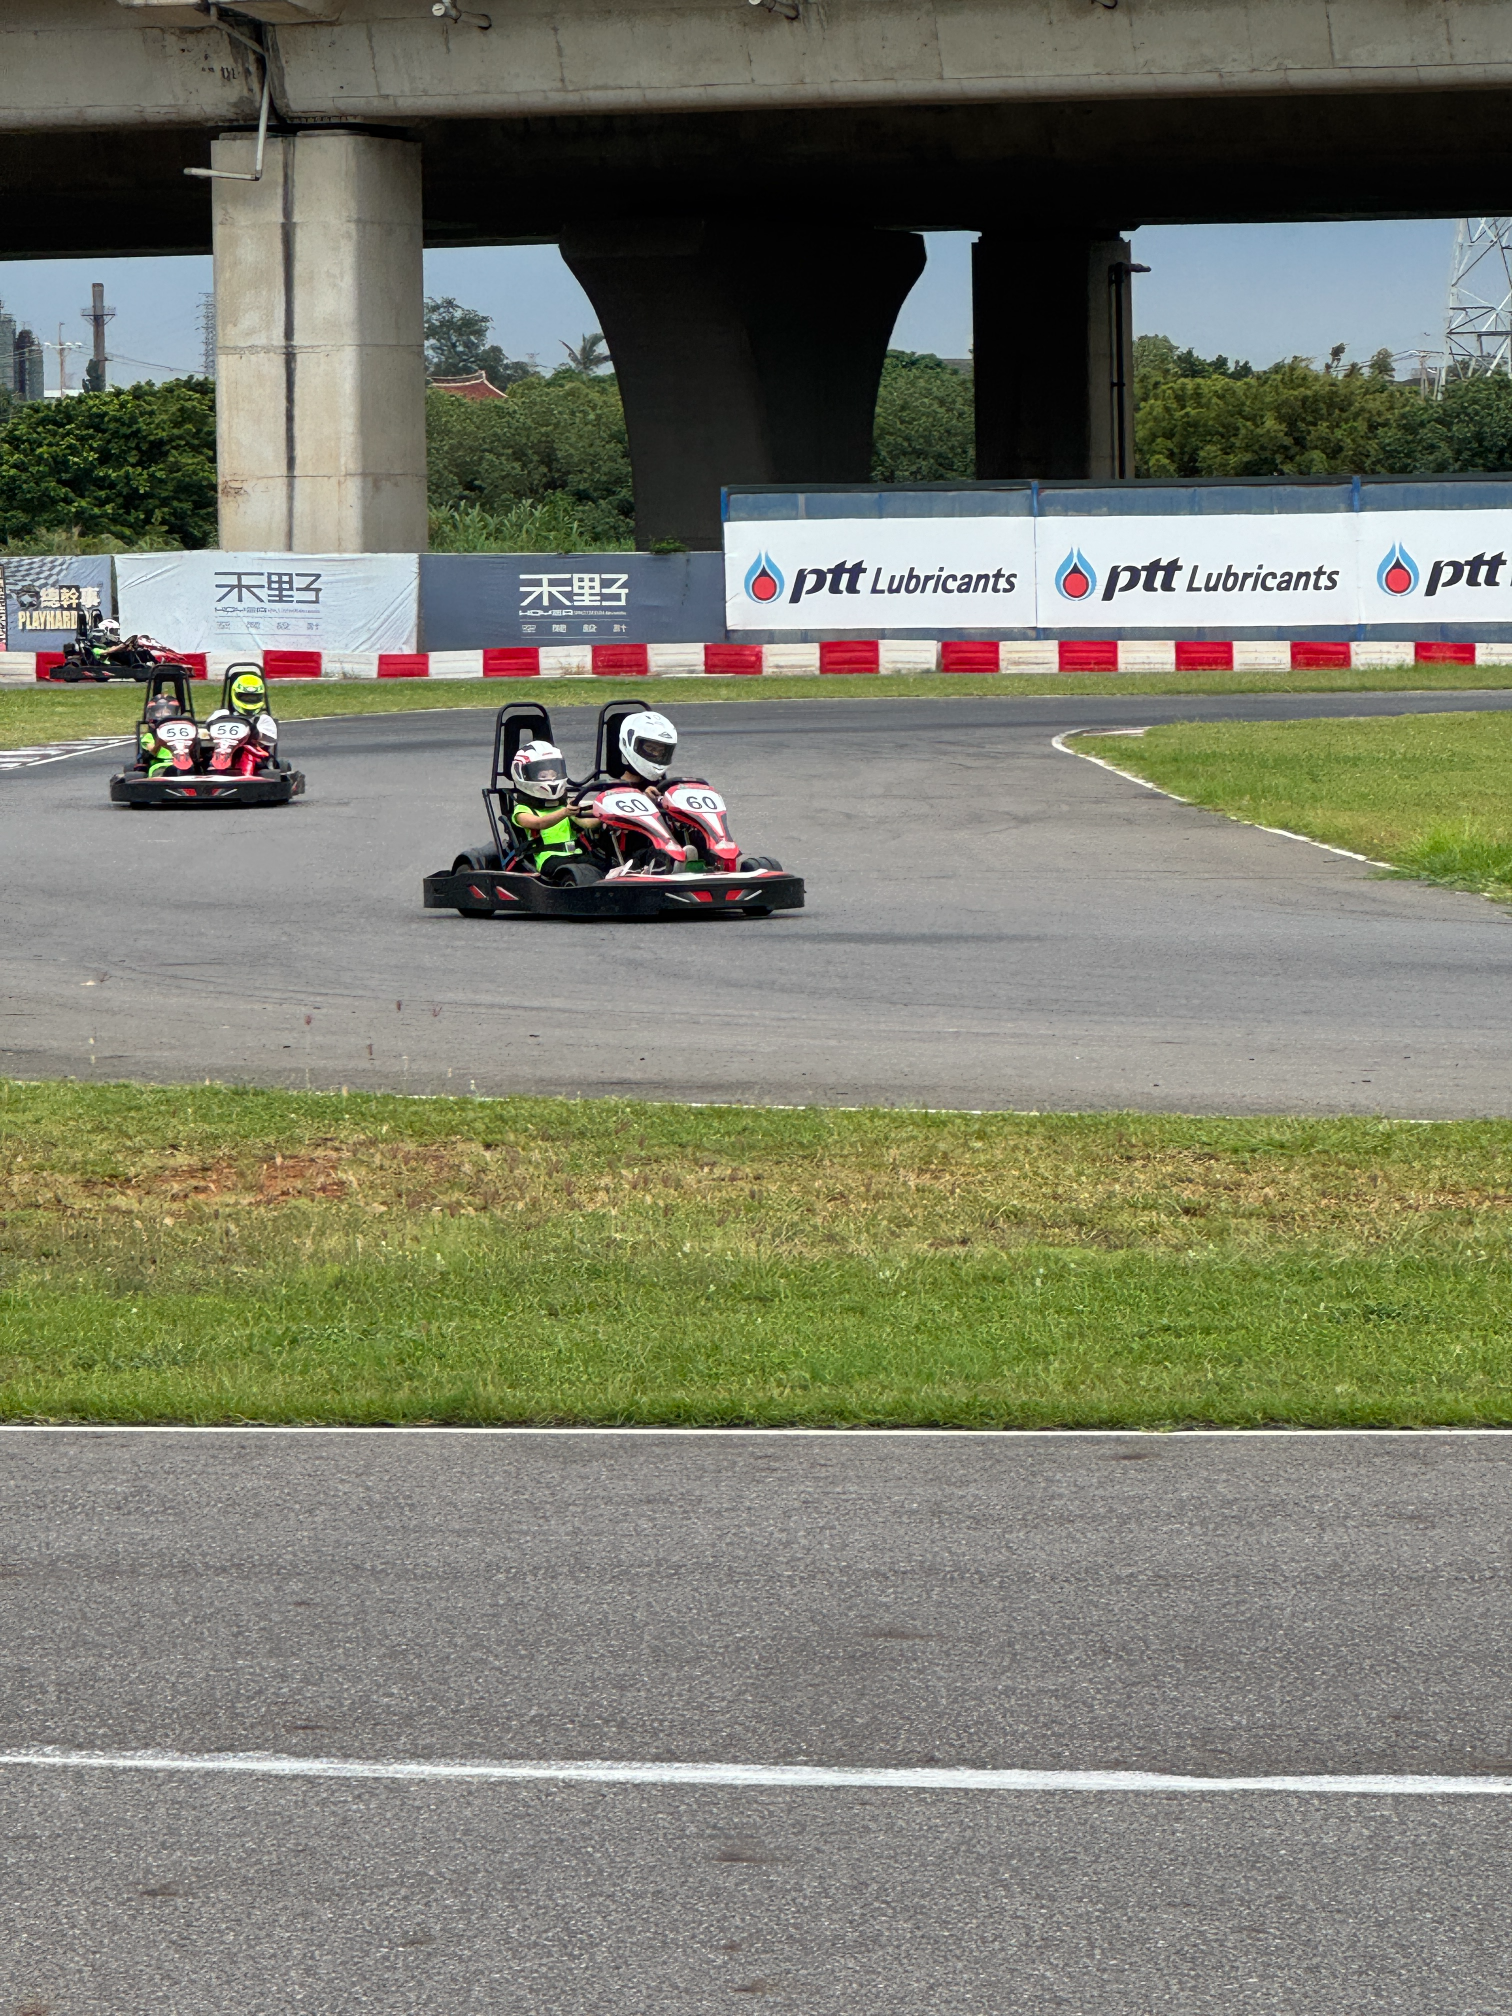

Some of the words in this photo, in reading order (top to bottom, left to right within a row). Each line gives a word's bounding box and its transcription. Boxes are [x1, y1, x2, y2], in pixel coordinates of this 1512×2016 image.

[214, 572, 322, 604] 禾野
[519, 573, 629, 606] 禾野
[789, 560, 867, 604] ptt
[870, 567, 1017, 594] Lubricants
[1101, 556, 1183, 601] ptt
[1186, 564, 1339, 593] Lubricants
[1424, 551, 1507, 597] ptt
[166, 727, 190, 738] 56
[217, 725, 240, 736] 56
[615, 798, 649, 813] 60
[686, 796, 717, 810] 60
